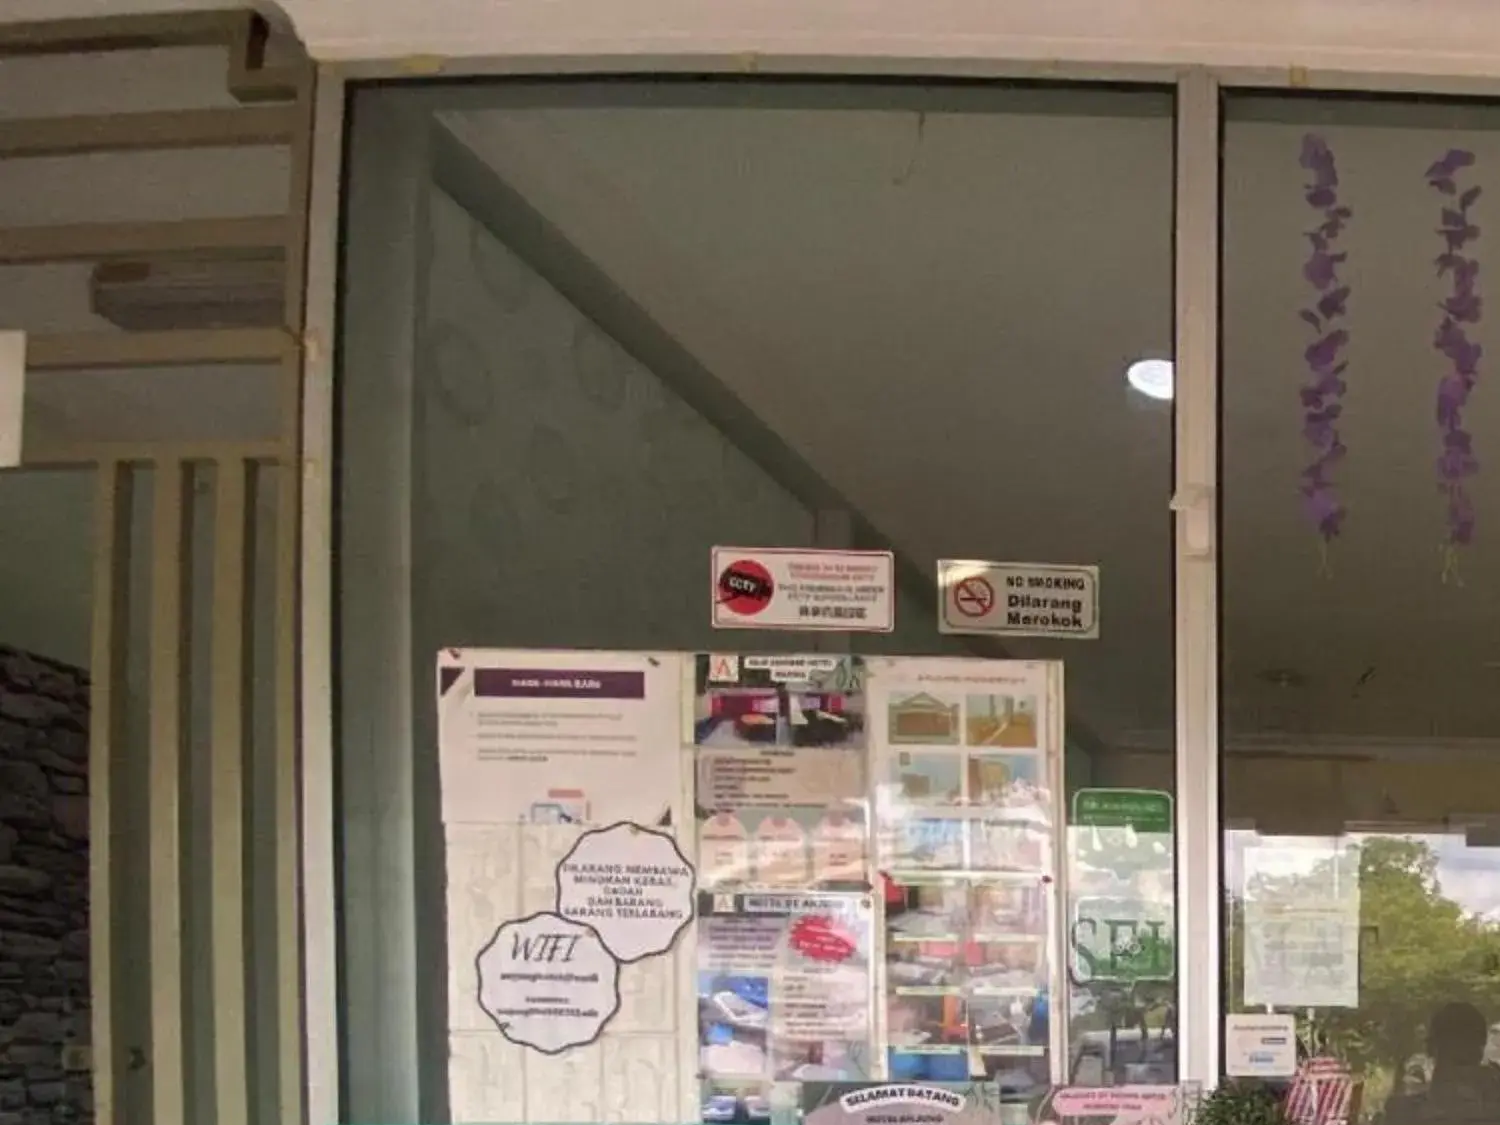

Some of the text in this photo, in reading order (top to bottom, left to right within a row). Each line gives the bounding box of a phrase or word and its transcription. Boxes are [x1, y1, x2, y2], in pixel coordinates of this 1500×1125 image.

[1008, 594, 1082, 614] Dilarang
[1007, 612, 1083, 629] Merokok
[511, 932, 583, 963] WIFI
[846, 1088, 905, 1106] SELAMAT
